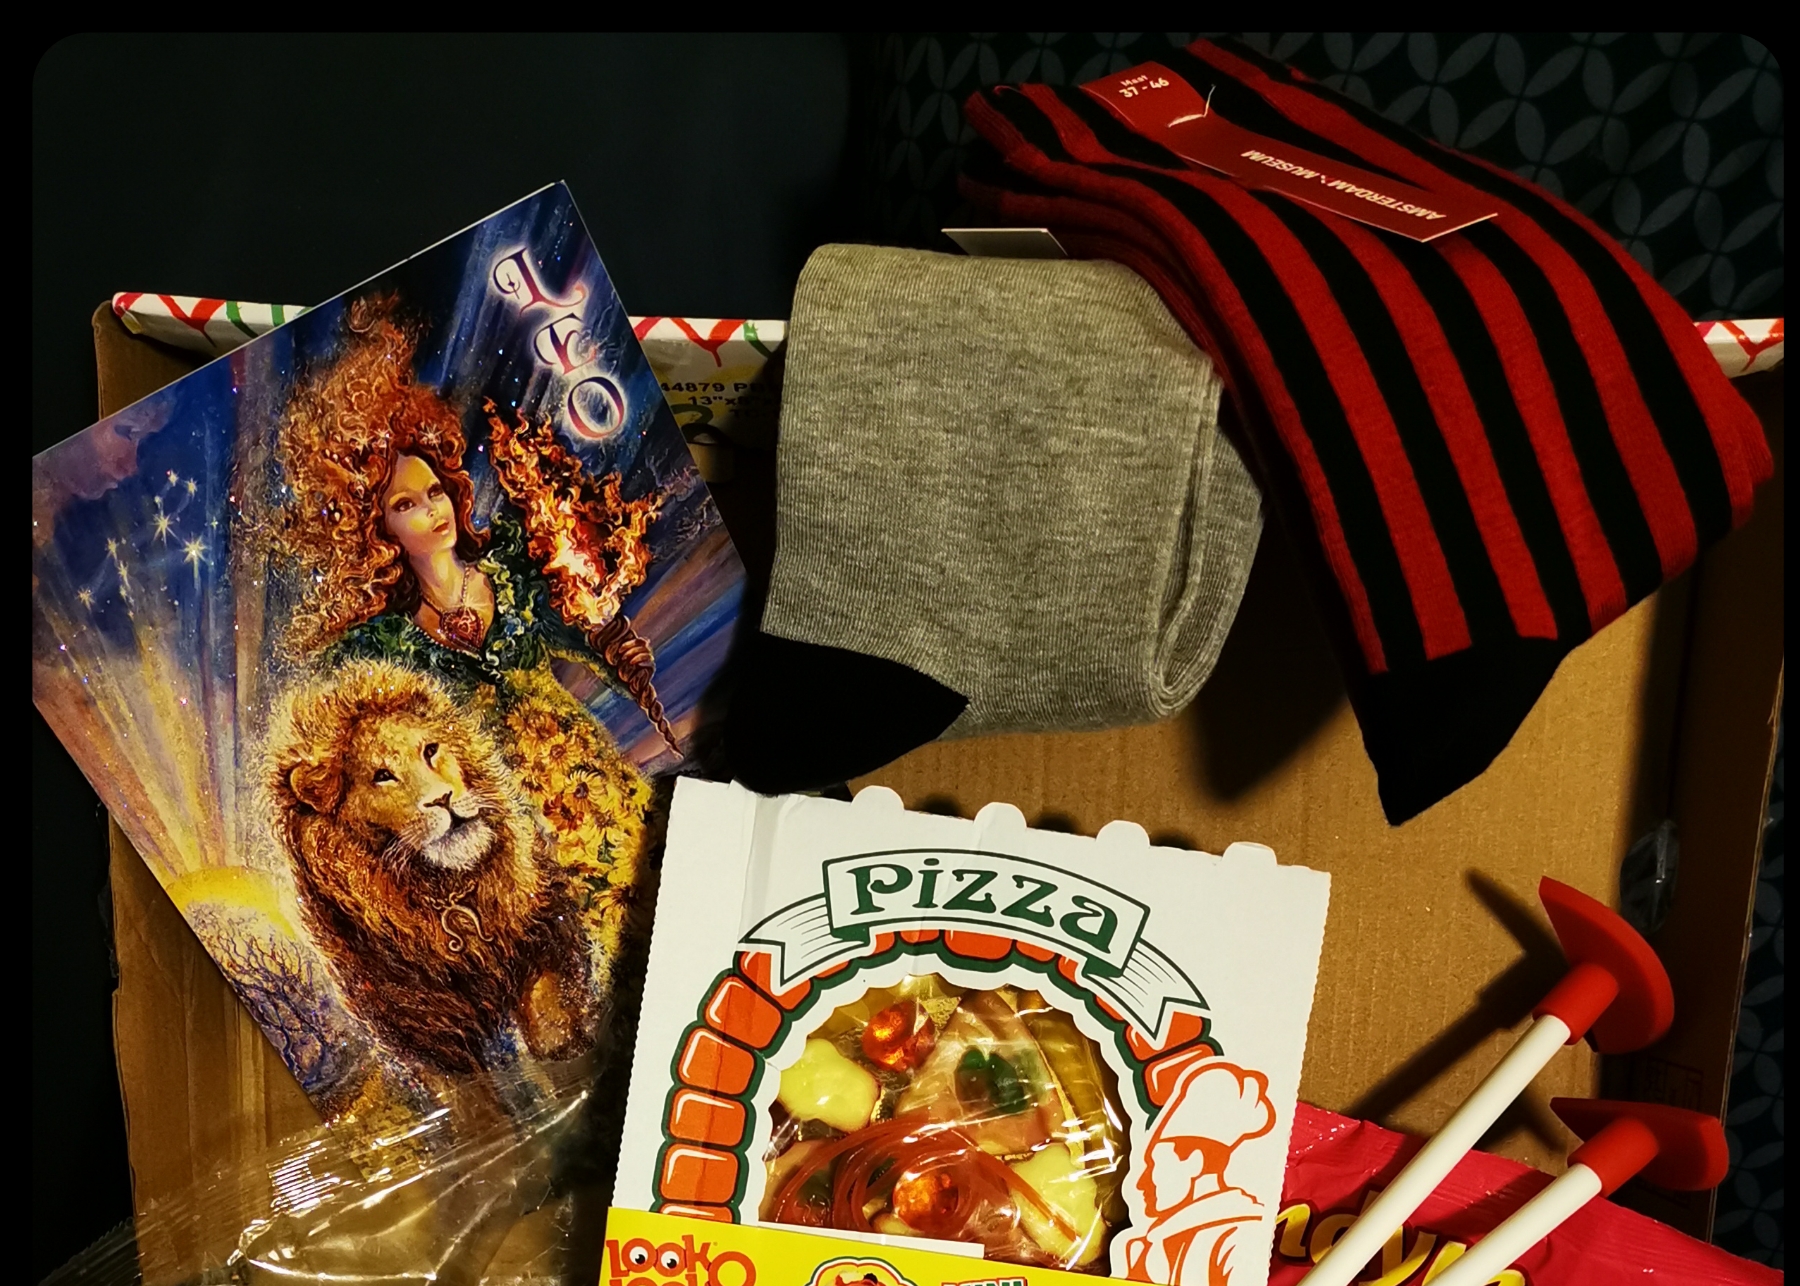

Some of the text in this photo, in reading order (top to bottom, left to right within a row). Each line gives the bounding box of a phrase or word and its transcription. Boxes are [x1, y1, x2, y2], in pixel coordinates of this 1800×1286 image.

[1118, 77, 1170, 98] 37 46
[1240, 150, 1448, 220] AMSTERDAM MUSEUM
[492, 247, 626, 439] LEO
[848, 858, 1122, 954] Pizza
